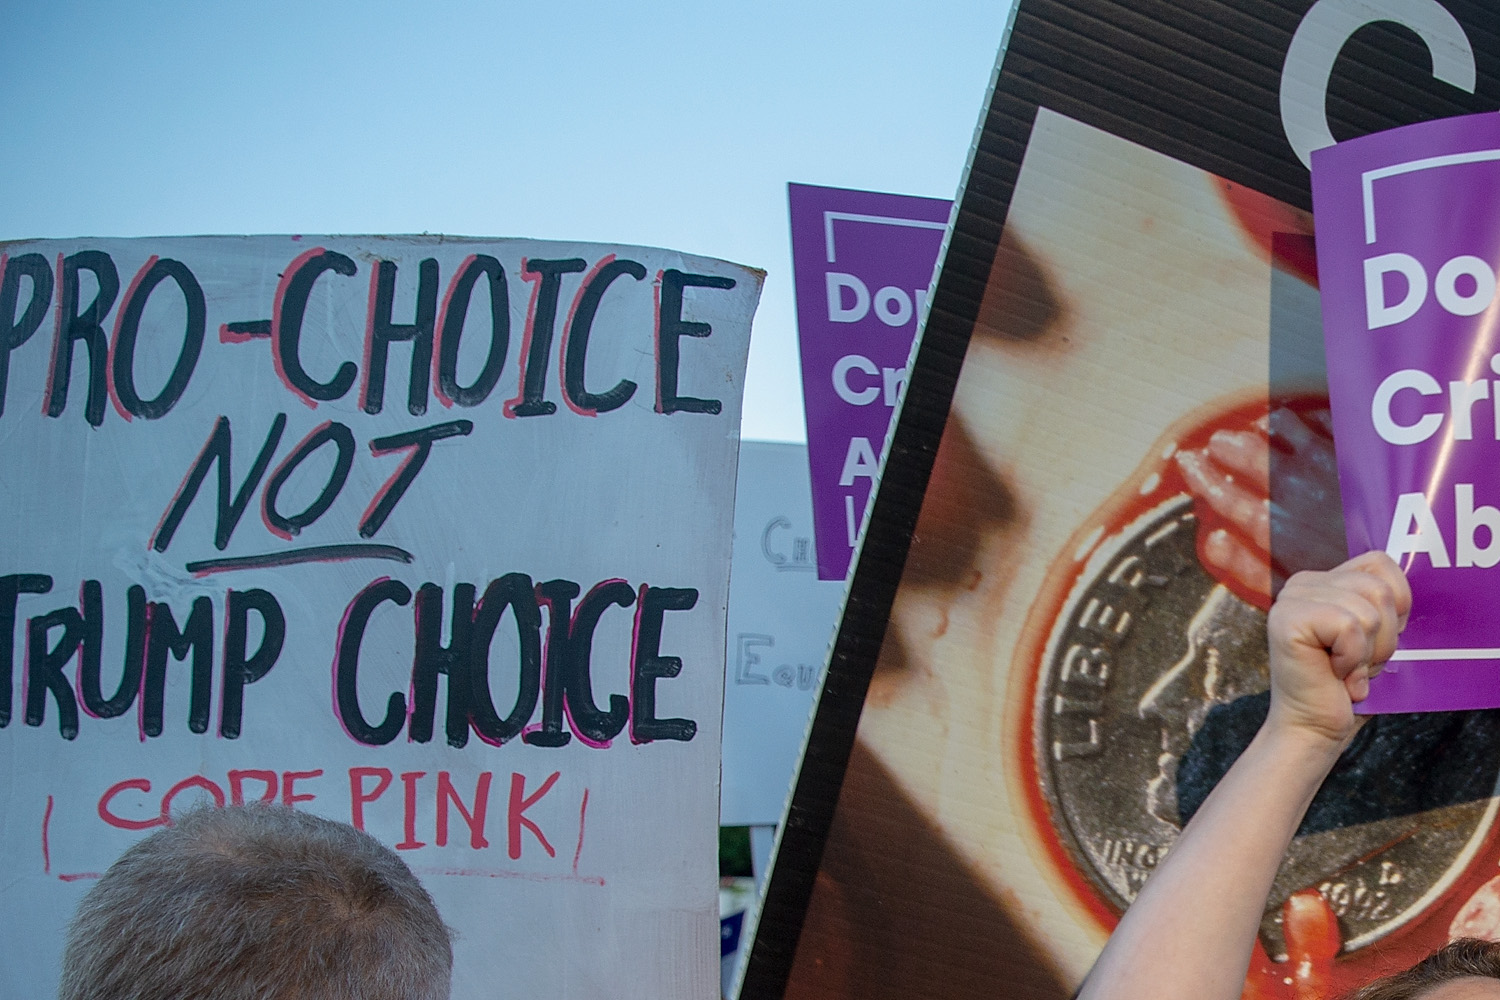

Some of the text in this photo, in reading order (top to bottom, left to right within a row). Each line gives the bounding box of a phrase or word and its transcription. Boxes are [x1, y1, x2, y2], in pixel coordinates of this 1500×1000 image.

[0, 250, 736, 428] PRO-CHOICE
[148, 412, 473, 553] NOT
[0, 573, 698, 748] TRUMP CHOICE
[349, 767, 561, 859] PINK
